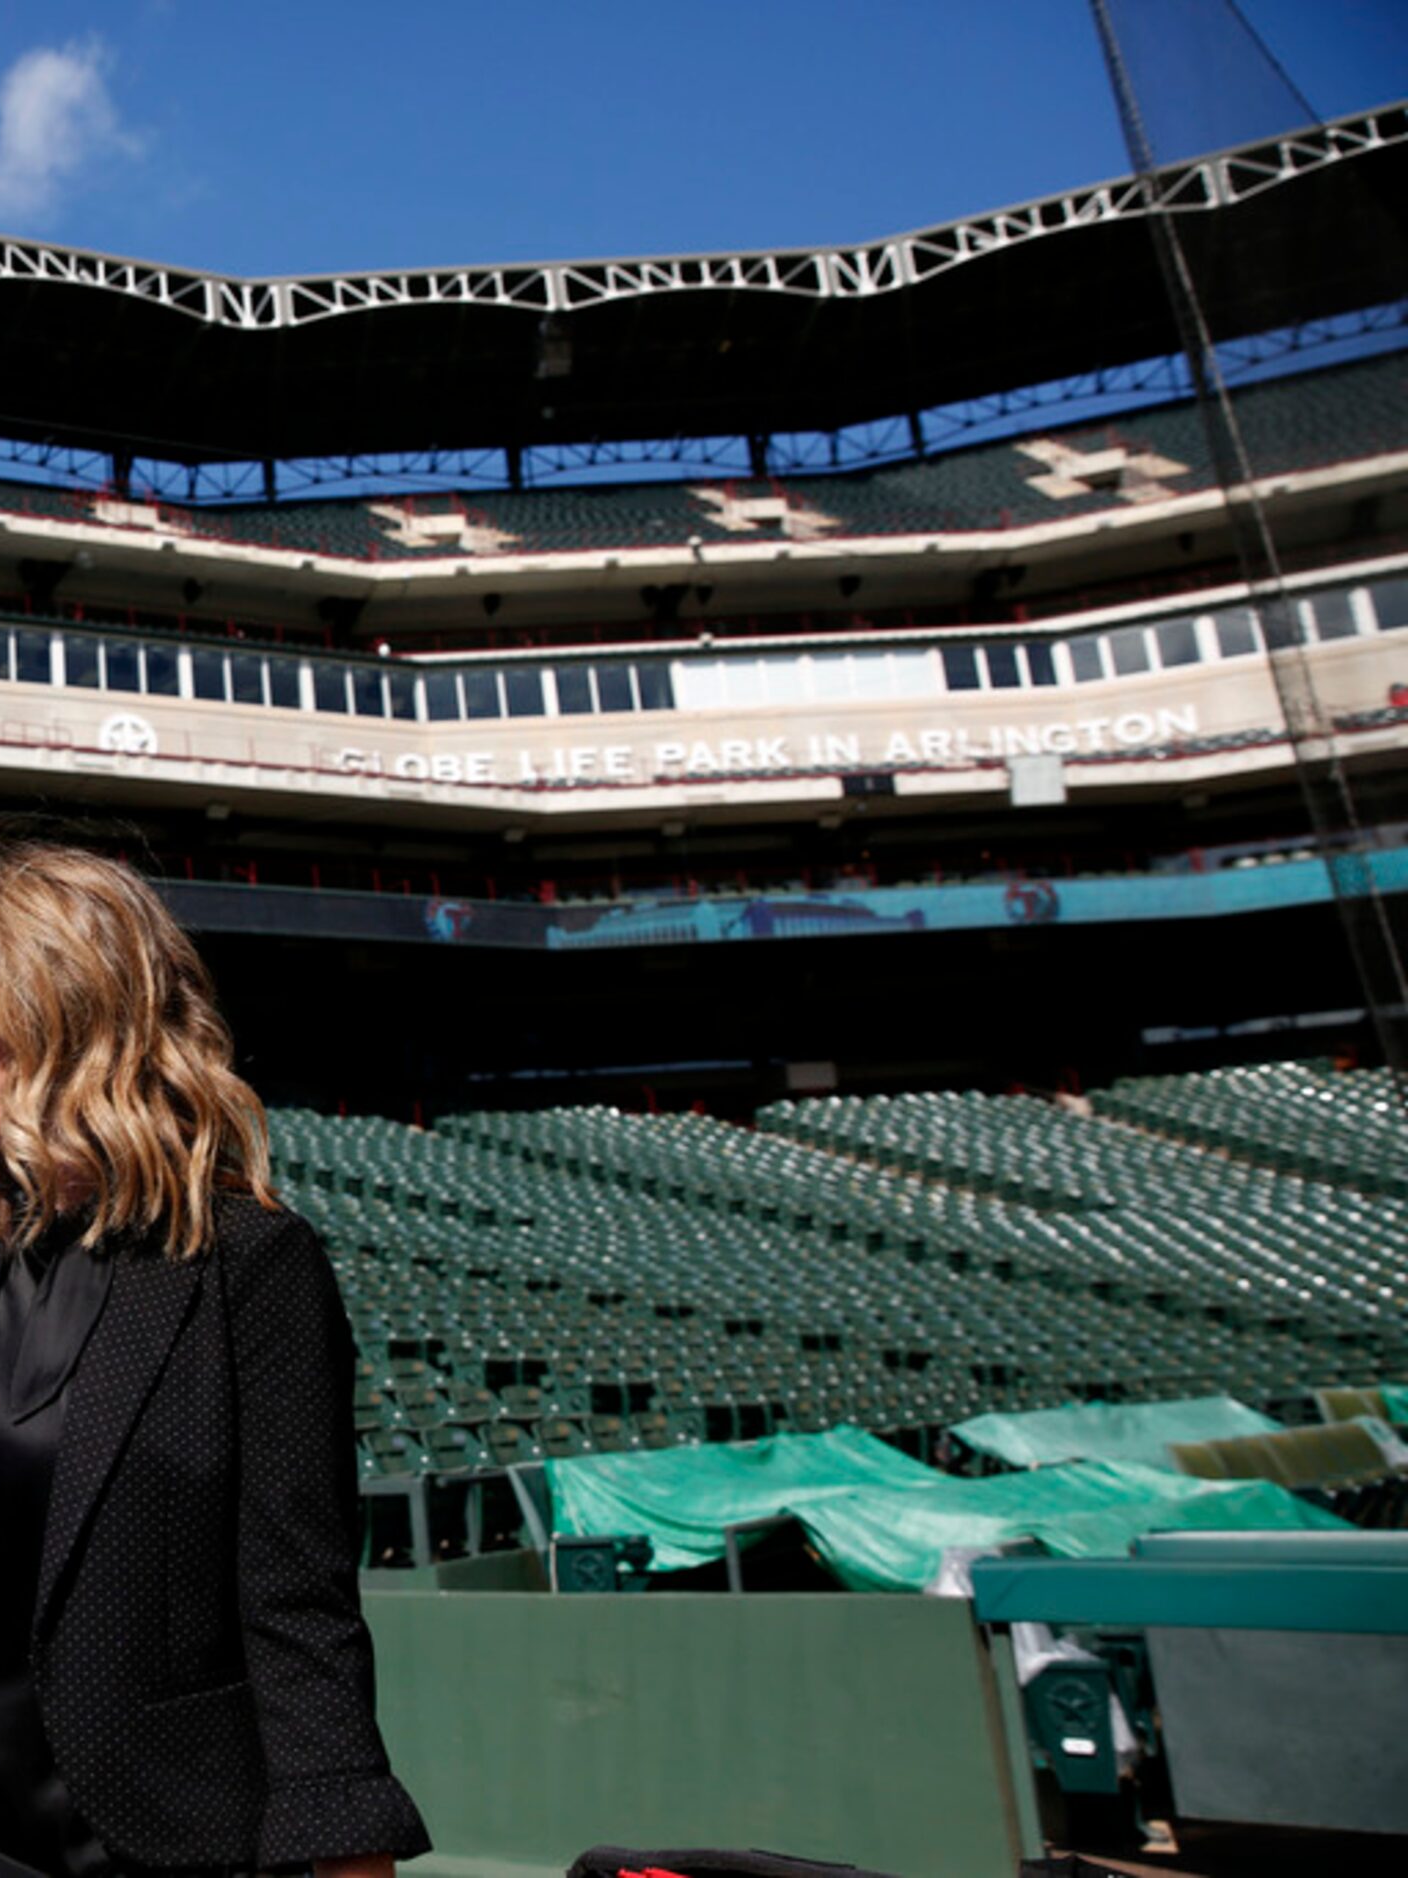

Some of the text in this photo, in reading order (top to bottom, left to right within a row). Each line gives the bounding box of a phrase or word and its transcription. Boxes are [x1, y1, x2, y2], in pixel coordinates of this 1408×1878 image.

[520, 745, 635, 781] LIFE
[653, 738, 791, 772] PARK
[810, 735, 860, 764] IN
[887, 704, 1199, 761] ARLINGTON
